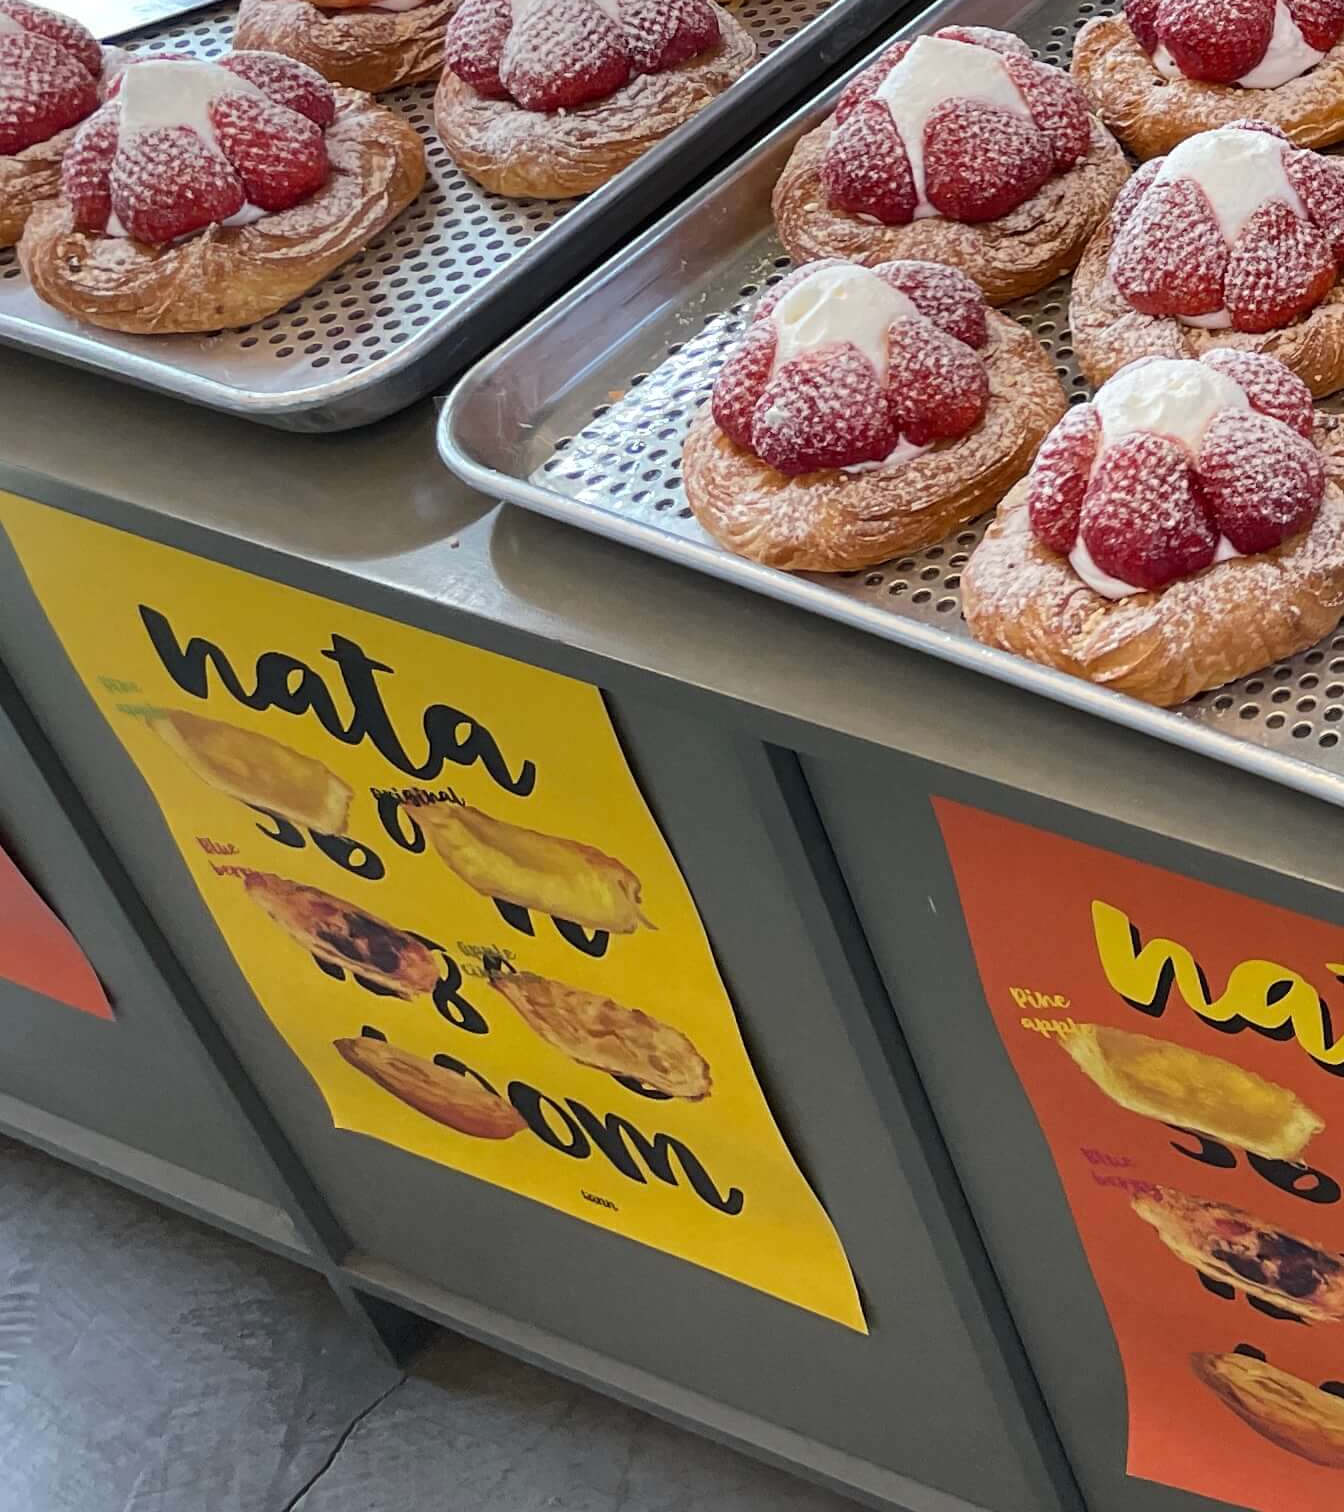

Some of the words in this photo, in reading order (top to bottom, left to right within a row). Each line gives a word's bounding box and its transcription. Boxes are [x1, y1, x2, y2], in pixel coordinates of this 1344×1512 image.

[137, 603, 537, 797] nata
[369, 786, 467, 808] original
[195, 836, 240, 856] Blue
[1008, 986, 1072, 1009] Pine
